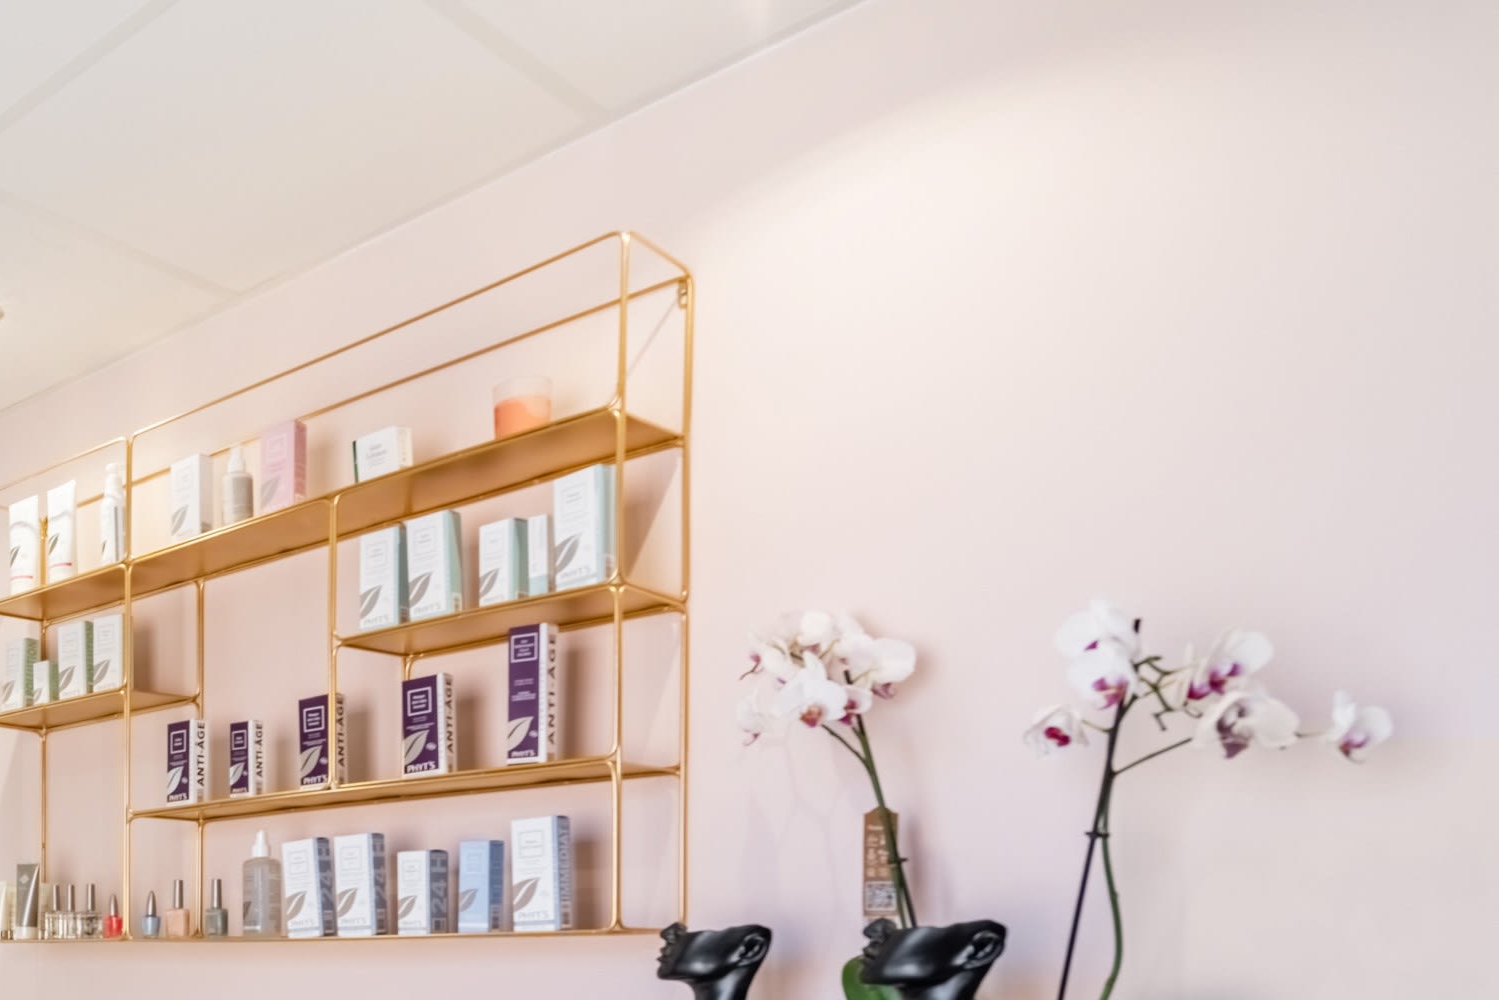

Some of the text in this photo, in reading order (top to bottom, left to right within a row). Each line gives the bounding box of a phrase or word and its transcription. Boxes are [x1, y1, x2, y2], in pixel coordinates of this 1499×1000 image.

[195, 721, 206, 786] ANTI-ÂGE
[253, 723, 264, 778] ANTI-ÂGE
[406, 760, 437, 773] PHYT'S
[302, 774, 328, 785] PHYT'S
[169, 792, 188, 801] PHYT'S
